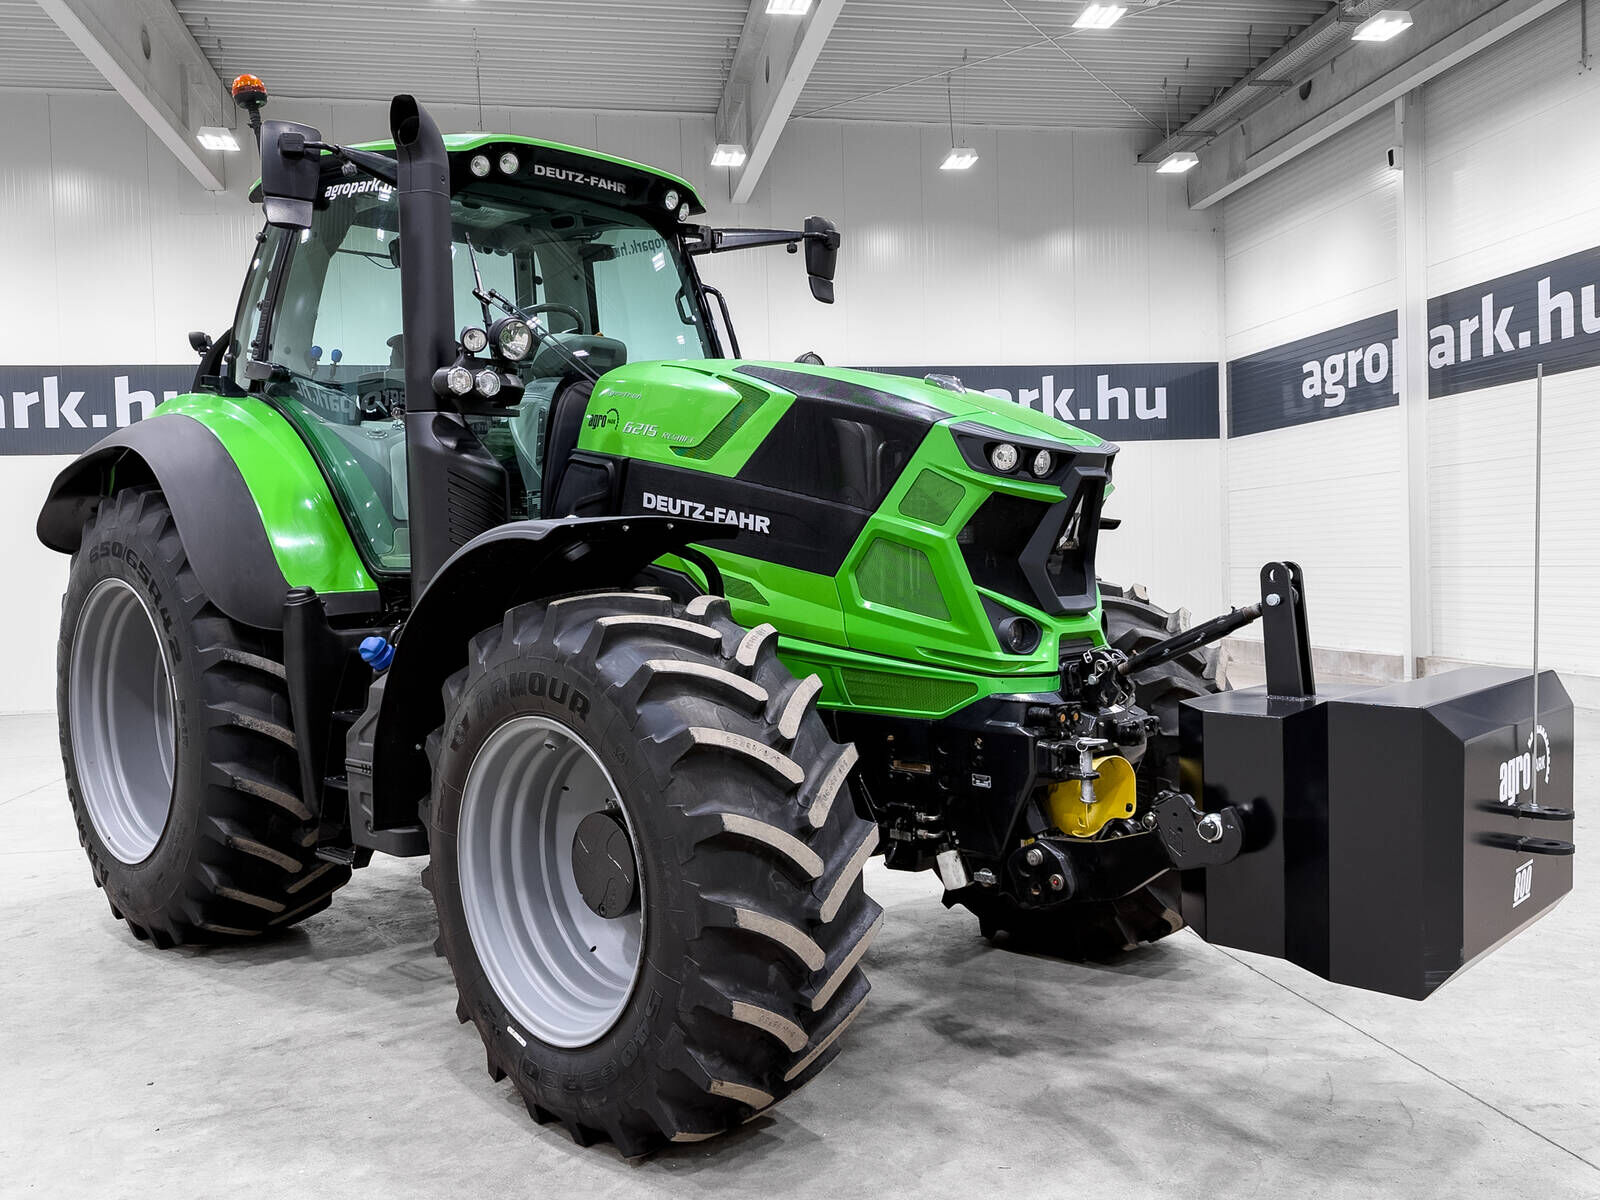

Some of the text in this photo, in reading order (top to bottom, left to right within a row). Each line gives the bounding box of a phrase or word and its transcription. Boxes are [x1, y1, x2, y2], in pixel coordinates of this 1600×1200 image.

[533, 164, 627, 195] DEUTZ-FAHR
[622, 421, 658, 438] 6215
[642, 491, 771, 534] DEUTZ-FAHR
[1499, 752, 1531, 807] agro
